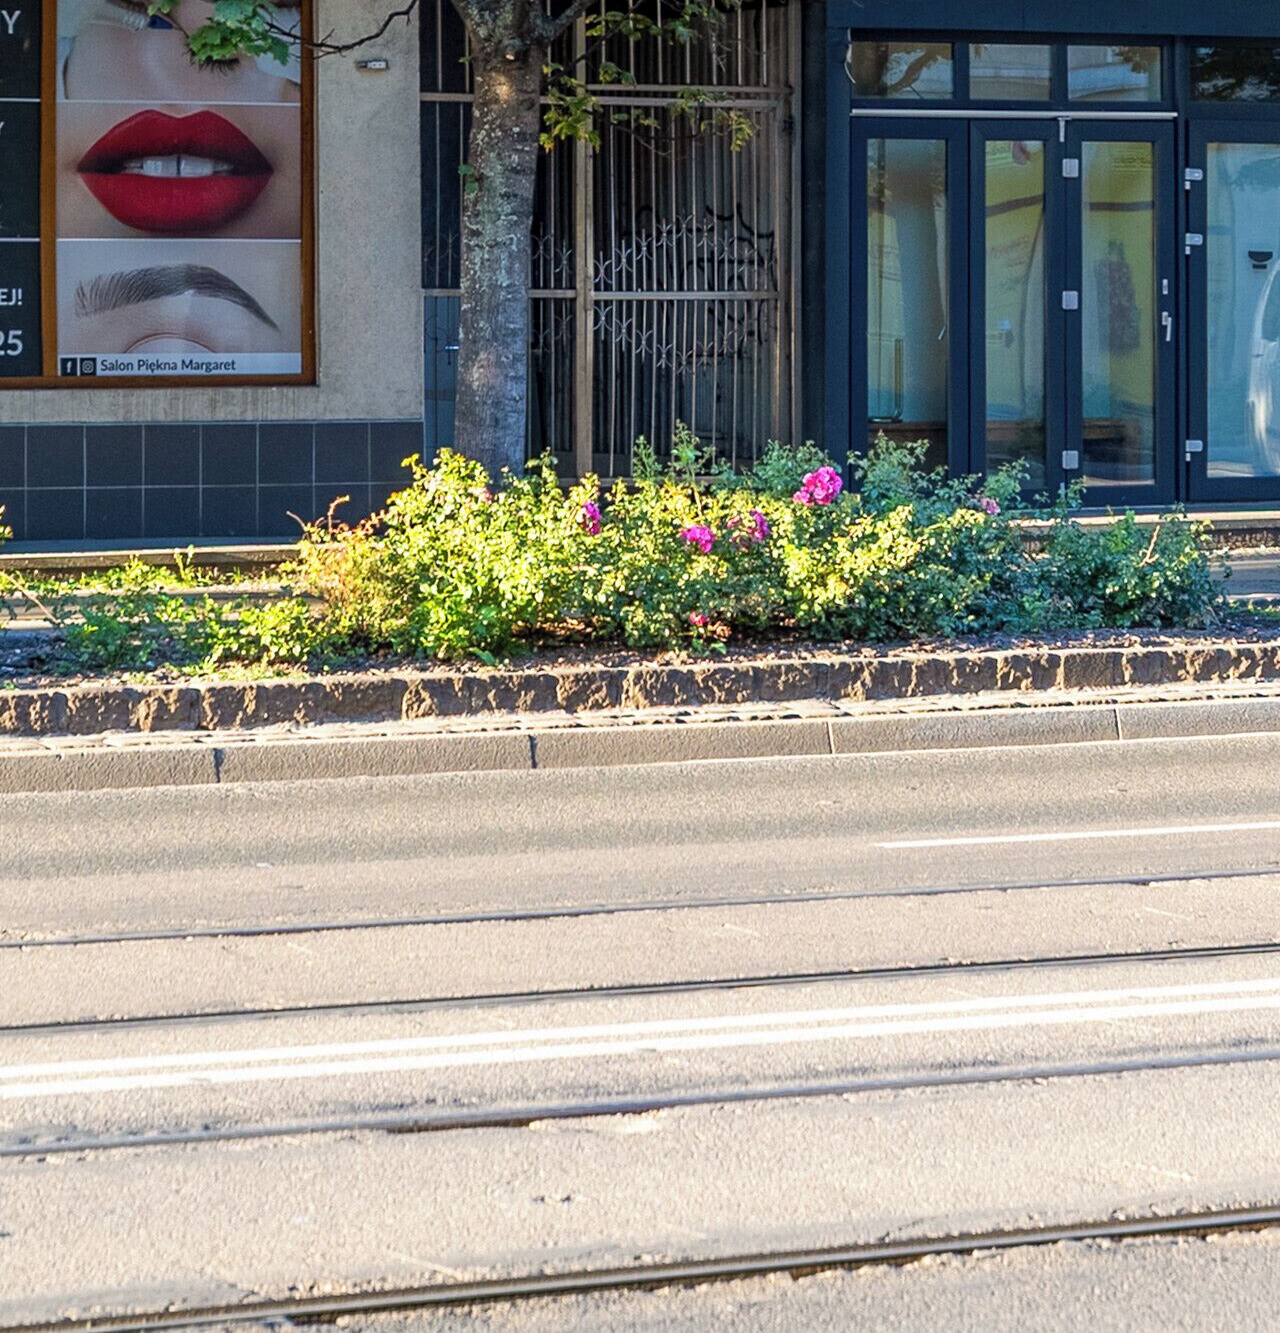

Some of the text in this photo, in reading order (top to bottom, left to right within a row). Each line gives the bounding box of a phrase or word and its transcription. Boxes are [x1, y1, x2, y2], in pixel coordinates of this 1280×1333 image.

[100, 359, 134, 372] Salon
[137, 359, 178, 374] Piękna
[181, 359, 237, 373] Margaret
